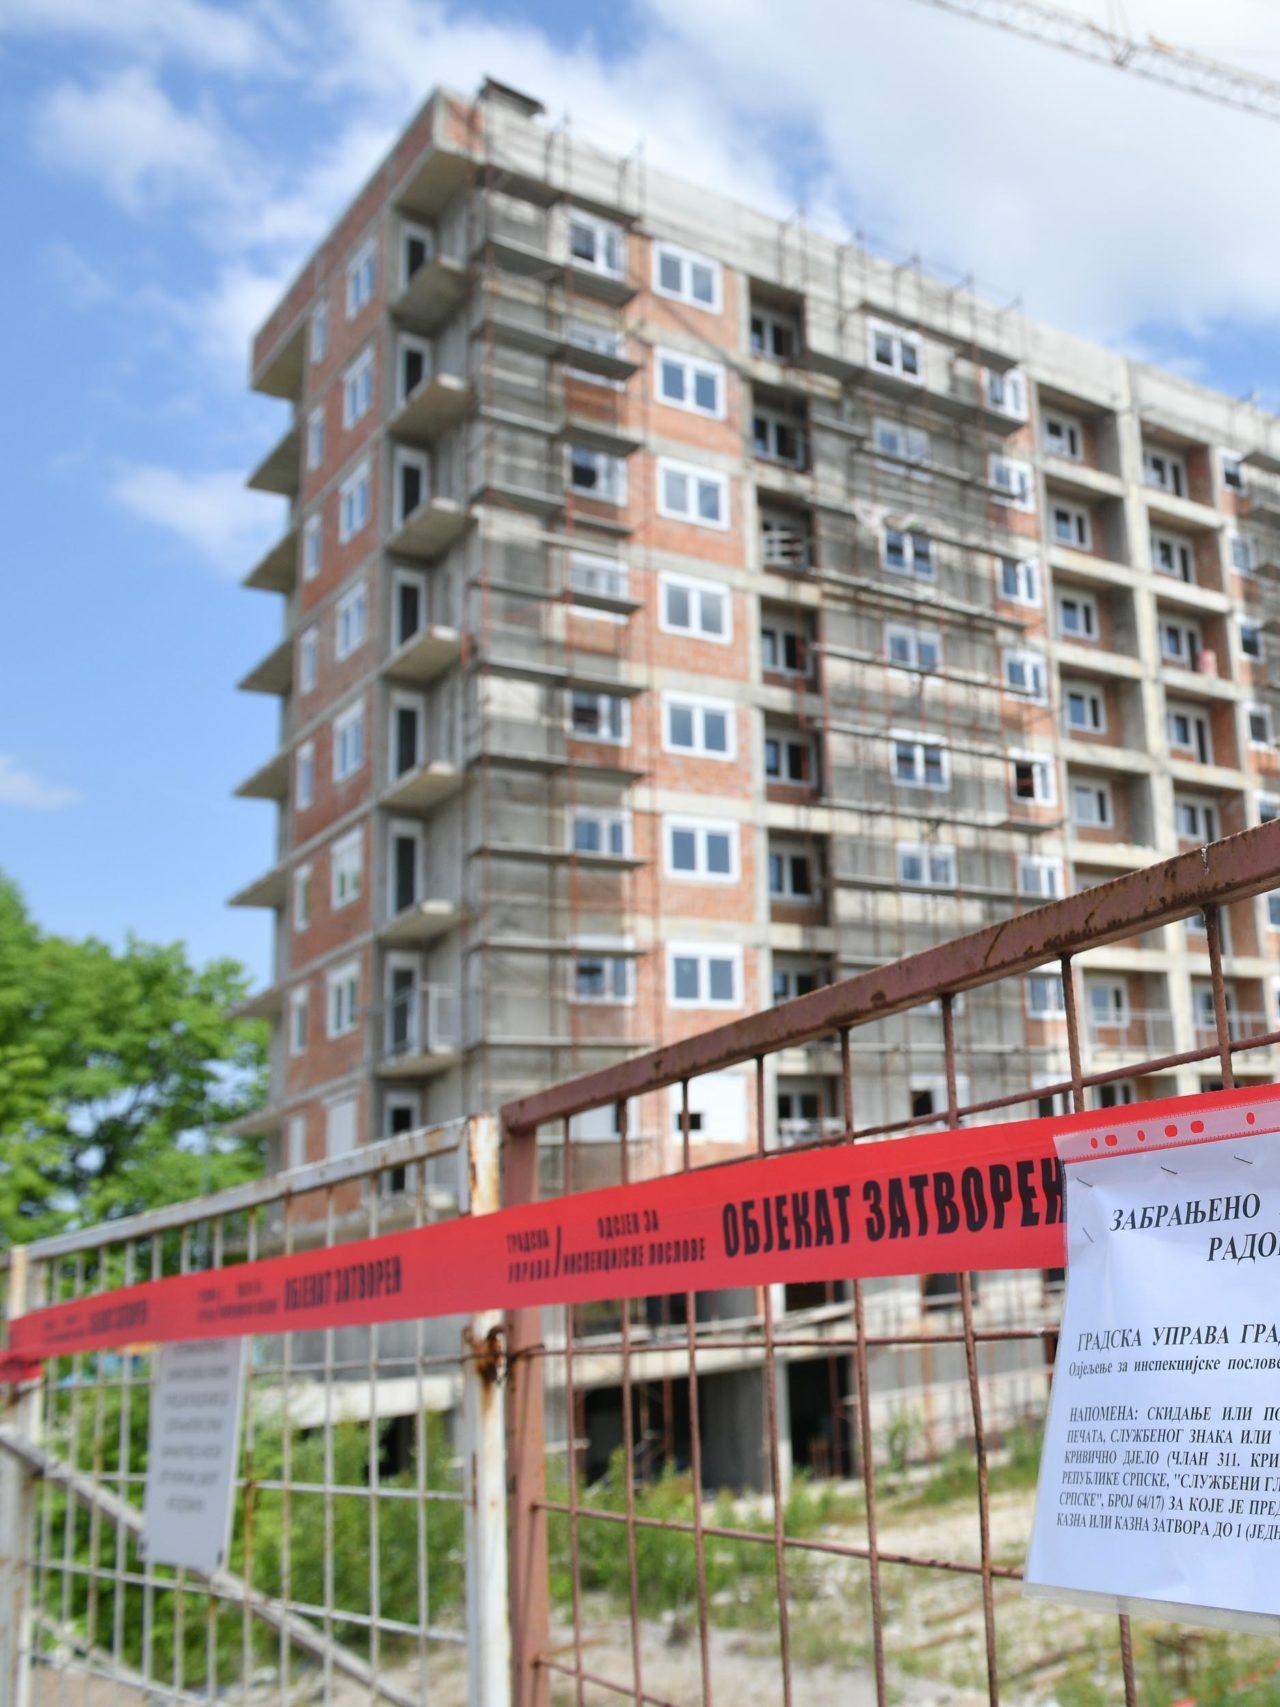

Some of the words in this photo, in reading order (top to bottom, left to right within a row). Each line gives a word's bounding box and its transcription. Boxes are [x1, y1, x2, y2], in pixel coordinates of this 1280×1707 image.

[723, 1185, 851, 1258] ОБЈЕКАТ
[863, 1157, 1066, 1243] ЗАТВОРЕН
[1109, 1193, 1261, 1232] ЗАБРАЊЕНО
[1078, 1328, 1142, 1352] ГРАДСКА
[1153, 1325, 1229, 1345] УПРАВА
[1117, 1361, 1128, 1373] за
[1134, 1355, 1220, 1374] инспекцијске
[1069, 1406, 1138, 1422] НАПОМЕНА:
[1147, 1406, 1211, 1422] СКИДАЊЕ
[1222, 1407, 1252, 1421] ИЛИ
[1067, 1429, 1106, 1444] ПЕЧАТА,
[1110, 1429, 1184, 1443] СЛУЖБЕНОГ
[1189, 1429, 1233, 1444] ЗНАКА
[1240, 1430, 1271, 1444] ИЛИ
[1064, 1450, 1117, 1464] КРИВИЧНО
[1123, 1450, 1159, 1466] ДЈЕЛО
[1167, 1451, 1208, 1468] (ЧЛАН
[1217, 1452, 1240, 1467] 311.
[1062, 1471, 1119, 1486] РЕПУБЛИКЕ
[1123, 1472, 1170, 1488] СРПСКЕ,
[1174, 1473, 1260, 1492] "СЛУЖБЕНИ
[1108, 1493, 1133, 1508] БРОЈ
[1136, 1495, 1165, 1512] 64/17)
[1168, 1496, 1184, 1511] ЗА
[1189, 1497, 1224, 1513] КОЈЕ
[1228, 1499, 1245, 1515] ЈЕ
[1057, 1513, 1086, 1527] КАЗНА
[1089, 1515, 1112, 1529] ИЛИ
[1115, 1516, 1150, 1532] КАЗНА
[1152, 1517, 1210, 1536] ЗАТВОРА
[1212, 1522, 1233, 1538] ДО
[1237, 1523, 1241, 1538] 1
